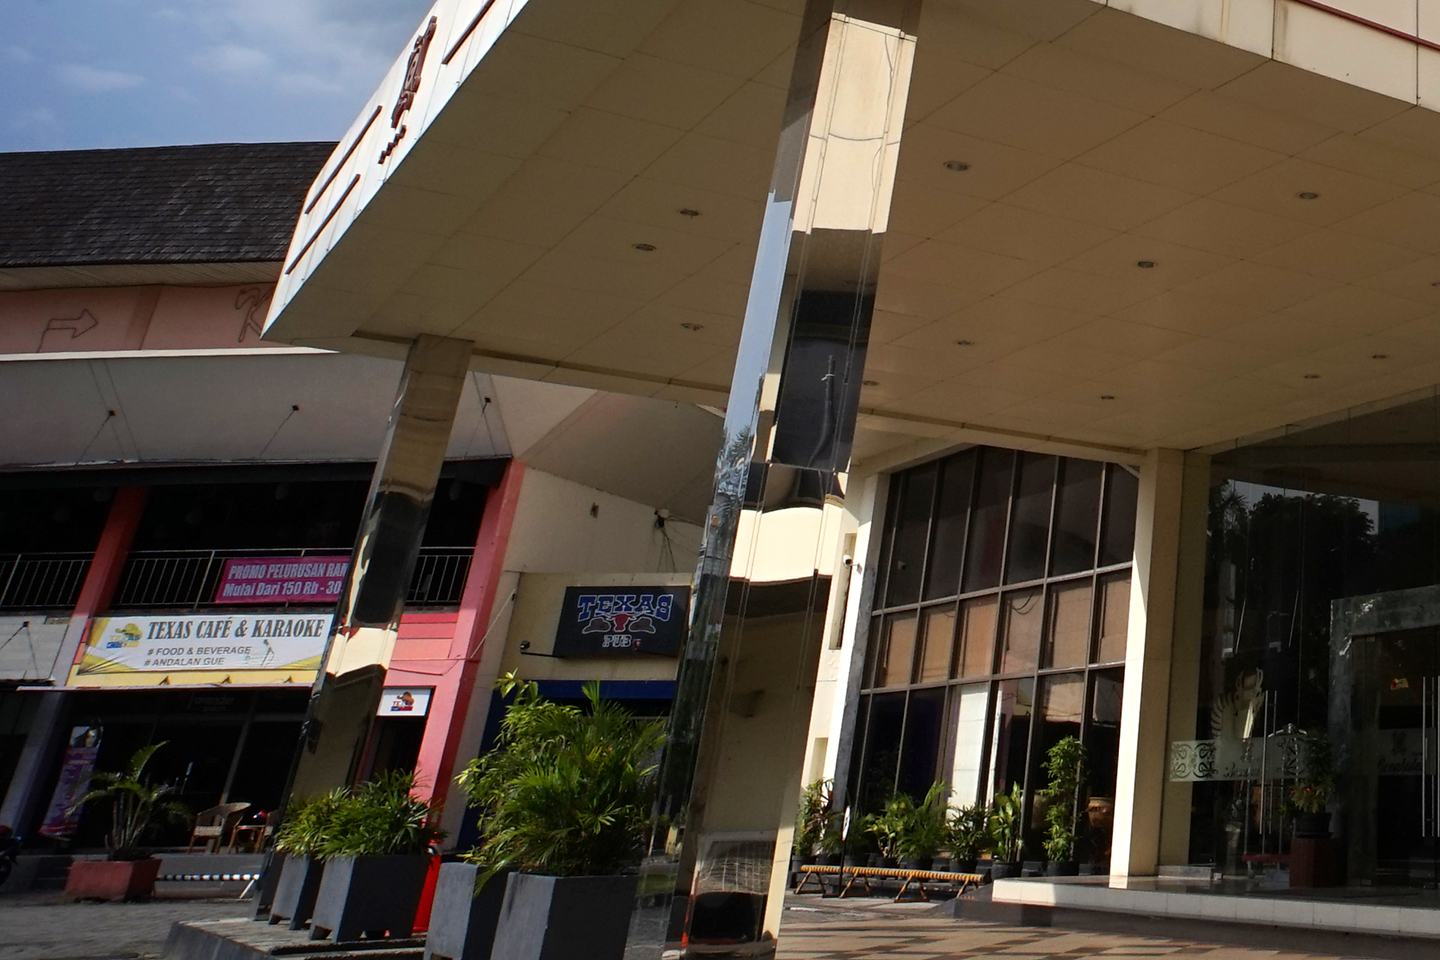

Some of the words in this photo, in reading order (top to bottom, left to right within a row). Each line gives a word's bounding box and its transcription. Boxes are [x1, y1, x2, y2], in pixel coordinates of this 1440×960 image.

[227, 564, 267, 580] PROMO
[266, 562, 326, 579] PELURUSAN
[222, 582, 256, 597] Mulai
[255, 582, 281, 596] Dari
[281, 581, 303, 595] 150
[302, 581, 319, 594] Rb
[325, 580, 344, 594] 30
[577, 594, 674, 622] TEXAS
[147, 620, 193, 640] TEXAS
[196, 616, 233, 639] CAFÉ
[234, 619, 249, 637] &
[250, 618, 325, 638] KARAOKE
[602, 634, 632, 648] PUB
[155, 647, 184, 656] FOOD
[196, 645, 252, 655] BEVERAGE
[151, 657, 202, 667] ANDALAN
[203, 656, 225, 666] GUE
